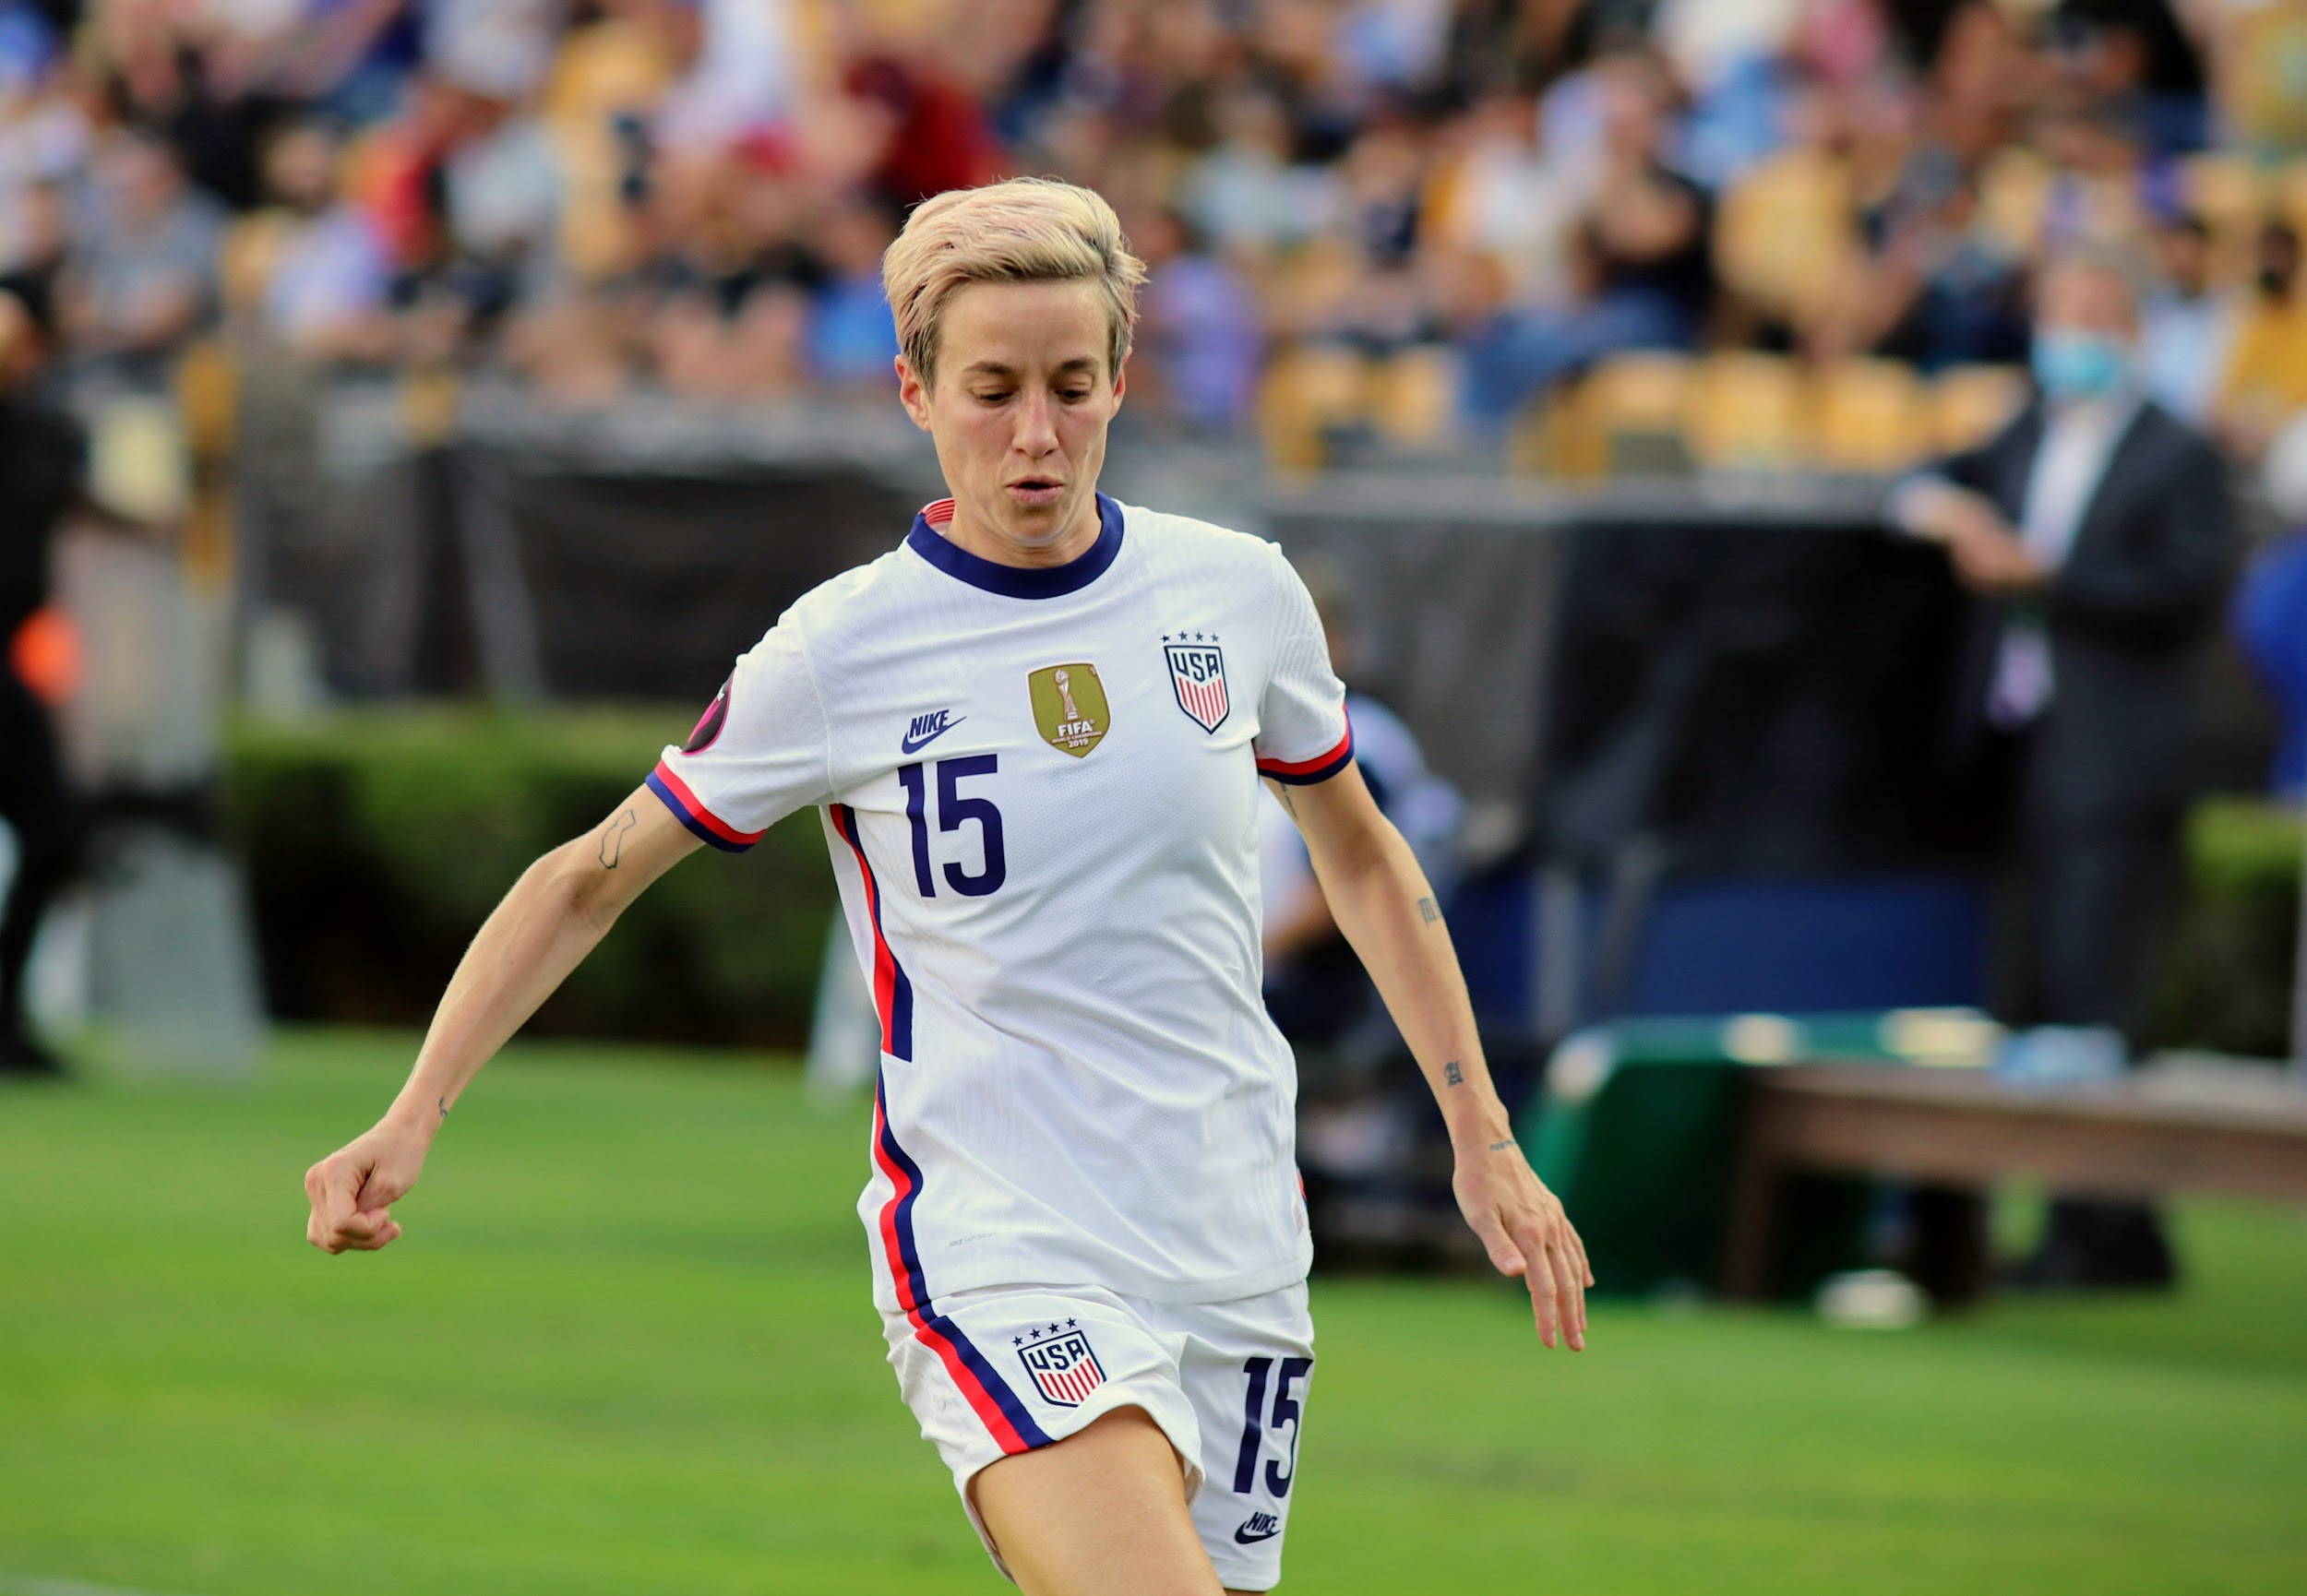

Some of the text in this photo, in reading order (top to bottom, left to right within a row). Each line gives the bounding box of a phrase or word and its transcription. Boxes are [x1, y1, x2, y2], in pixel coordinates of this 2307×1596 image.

[1173, 652, 1219, 683] USA
[909, 709, 950, 739] NIKE
[1058, 721, 1094, 737] FIFA
[1051, 735, 1071, 744] WORLD
[1068, 737, 1089, 749] 2019
[898, 754, 1006, 898] 15
[1028, 1339, 1085, 1371] USA
[1234, 1357, 1313, 1498] 15
[1246, 1511, 1278, 1532] NIKE
